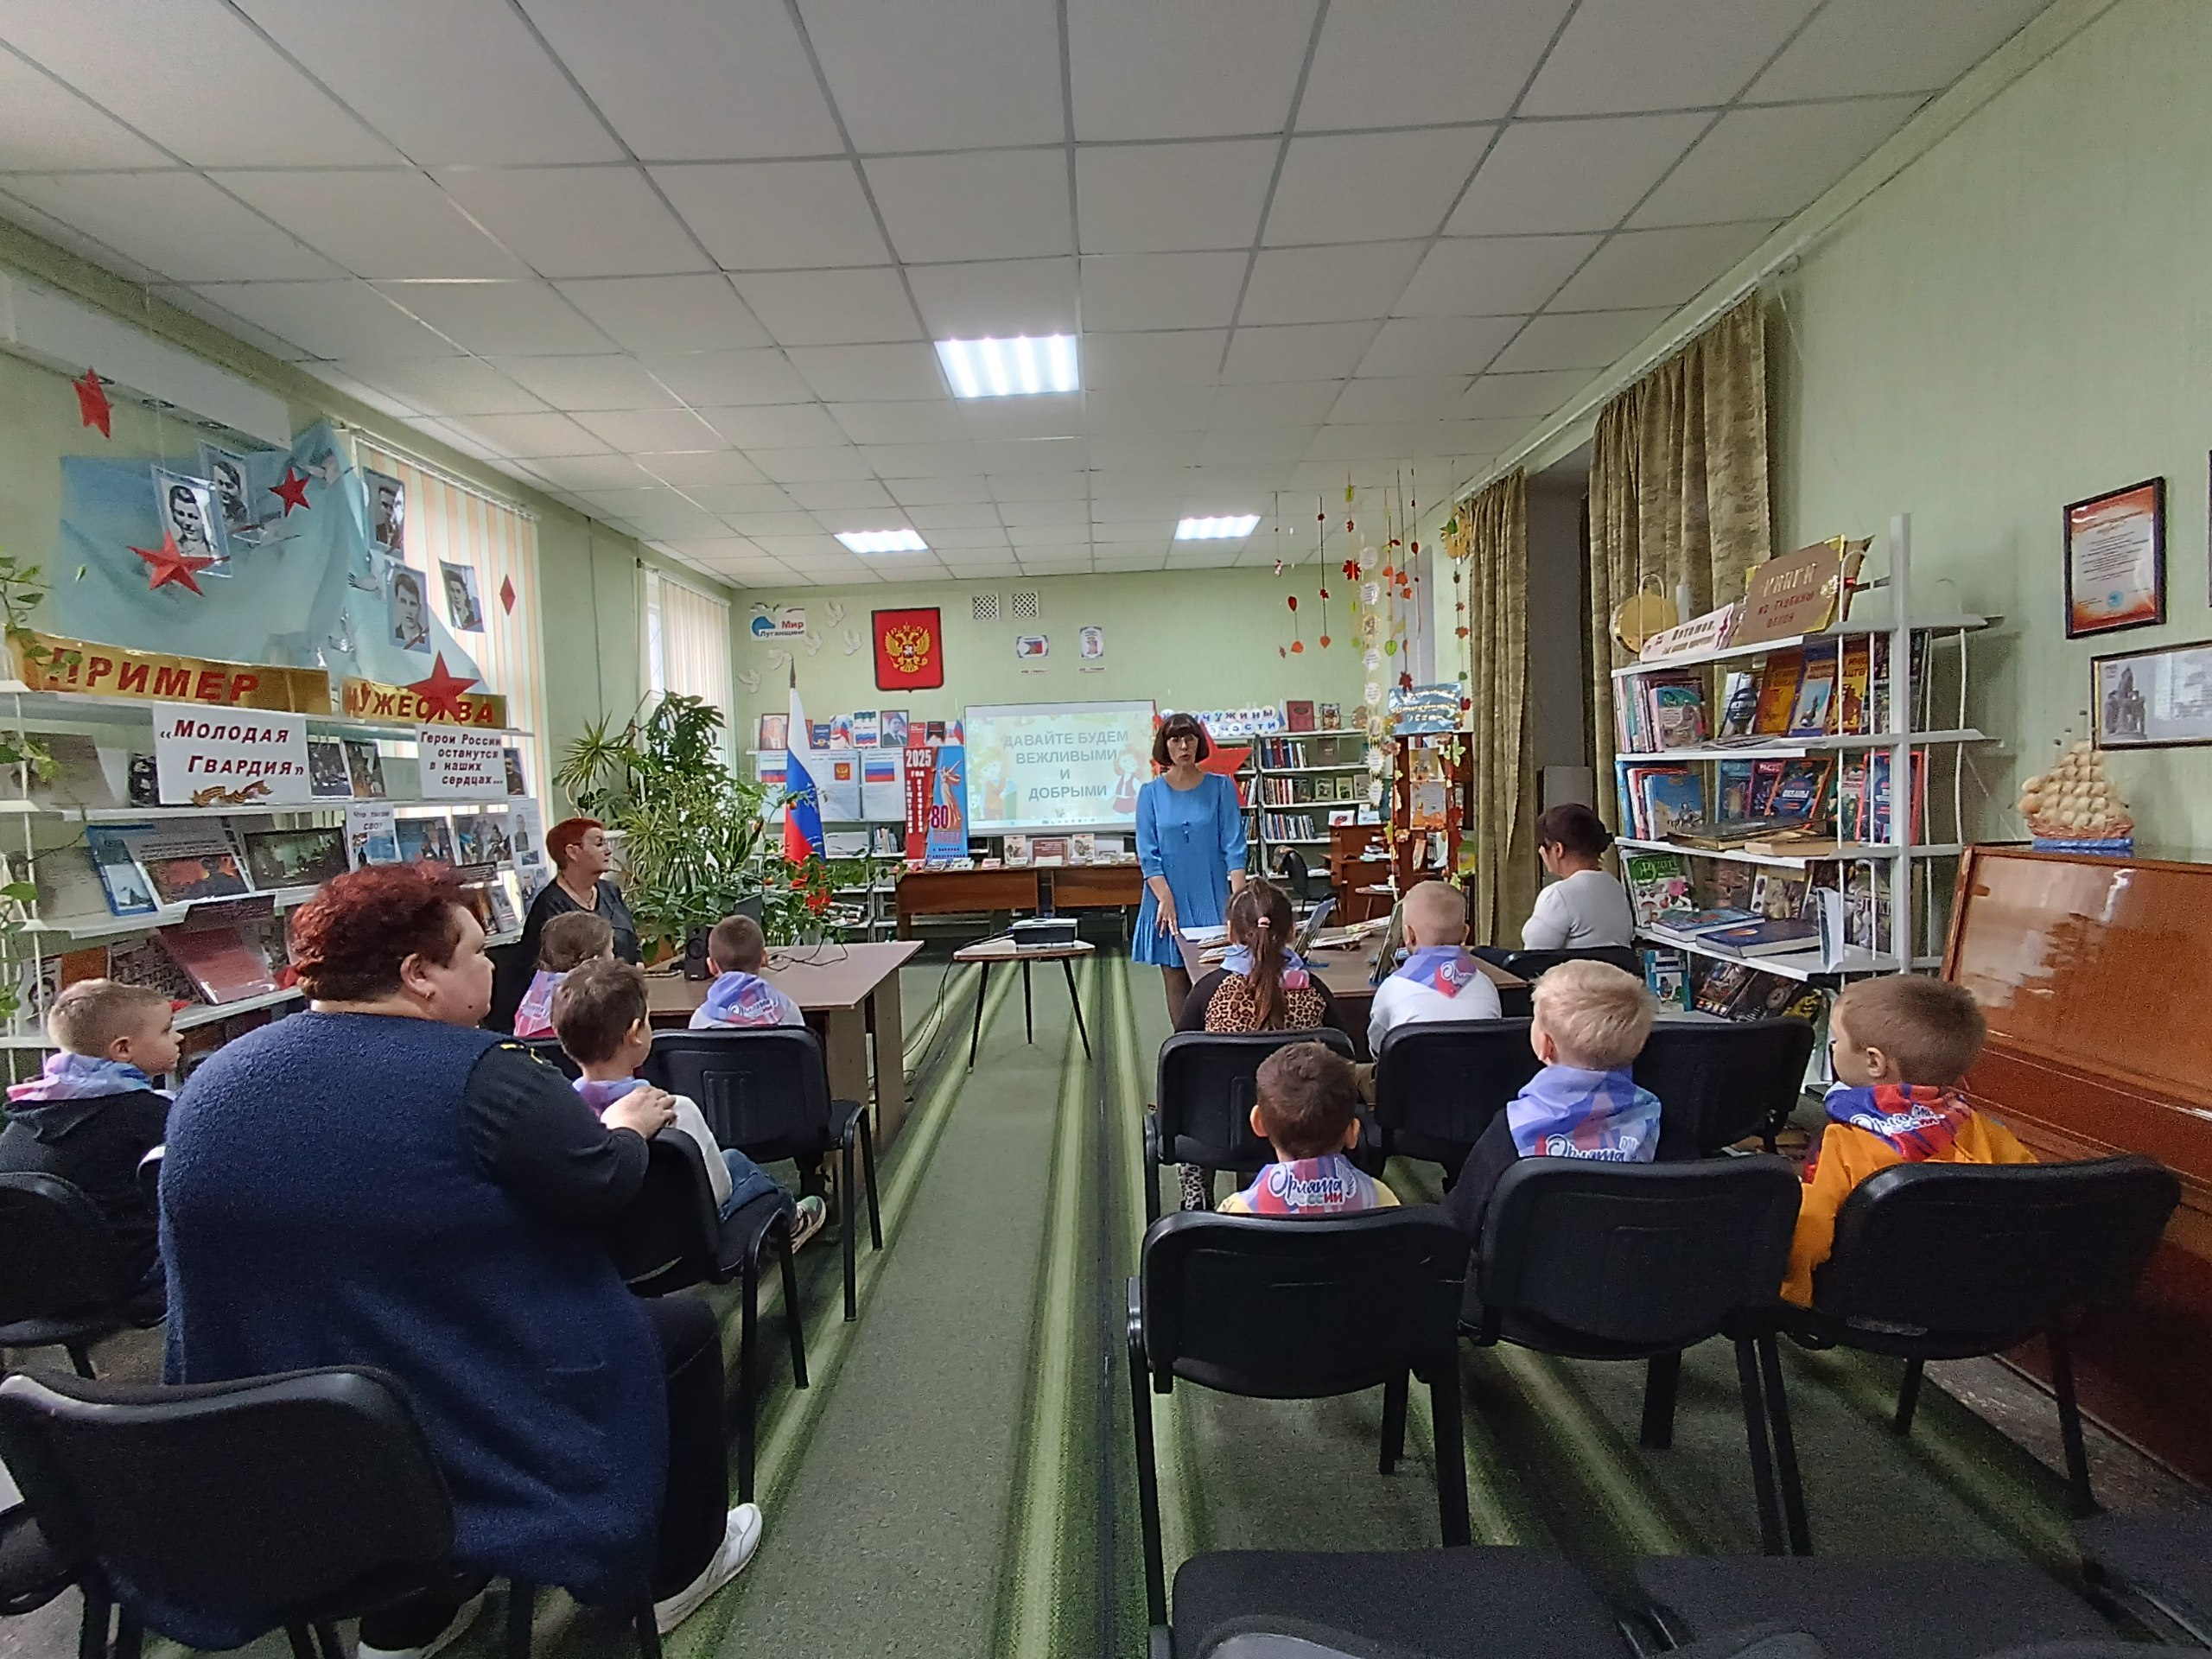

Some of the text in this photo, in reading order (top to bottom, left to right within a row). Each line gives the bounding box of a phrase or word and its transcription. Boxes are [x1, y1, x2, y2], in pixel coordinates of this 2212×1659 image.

[781, 620, 804, 629] Мир
[420, 732, 502, 747] Герои России
[1003, 731, 1129, 749] ДАВАЙТЕ БУДЕМ
[438, 747, 499, 761] останутся
[906, 749, 932, 767] 2025
[1015, 749, 1117, 764] ВЕЖЛИВЫМИ
[429, 761, 482, 772] в наших
[1060, 769, 1071, 779] И
[1028, 785, 1107, 802] ДОБРЫМИ
[931, 804, 950, 829] 80
[1269, 1163, 1343, 1199] Орлята
